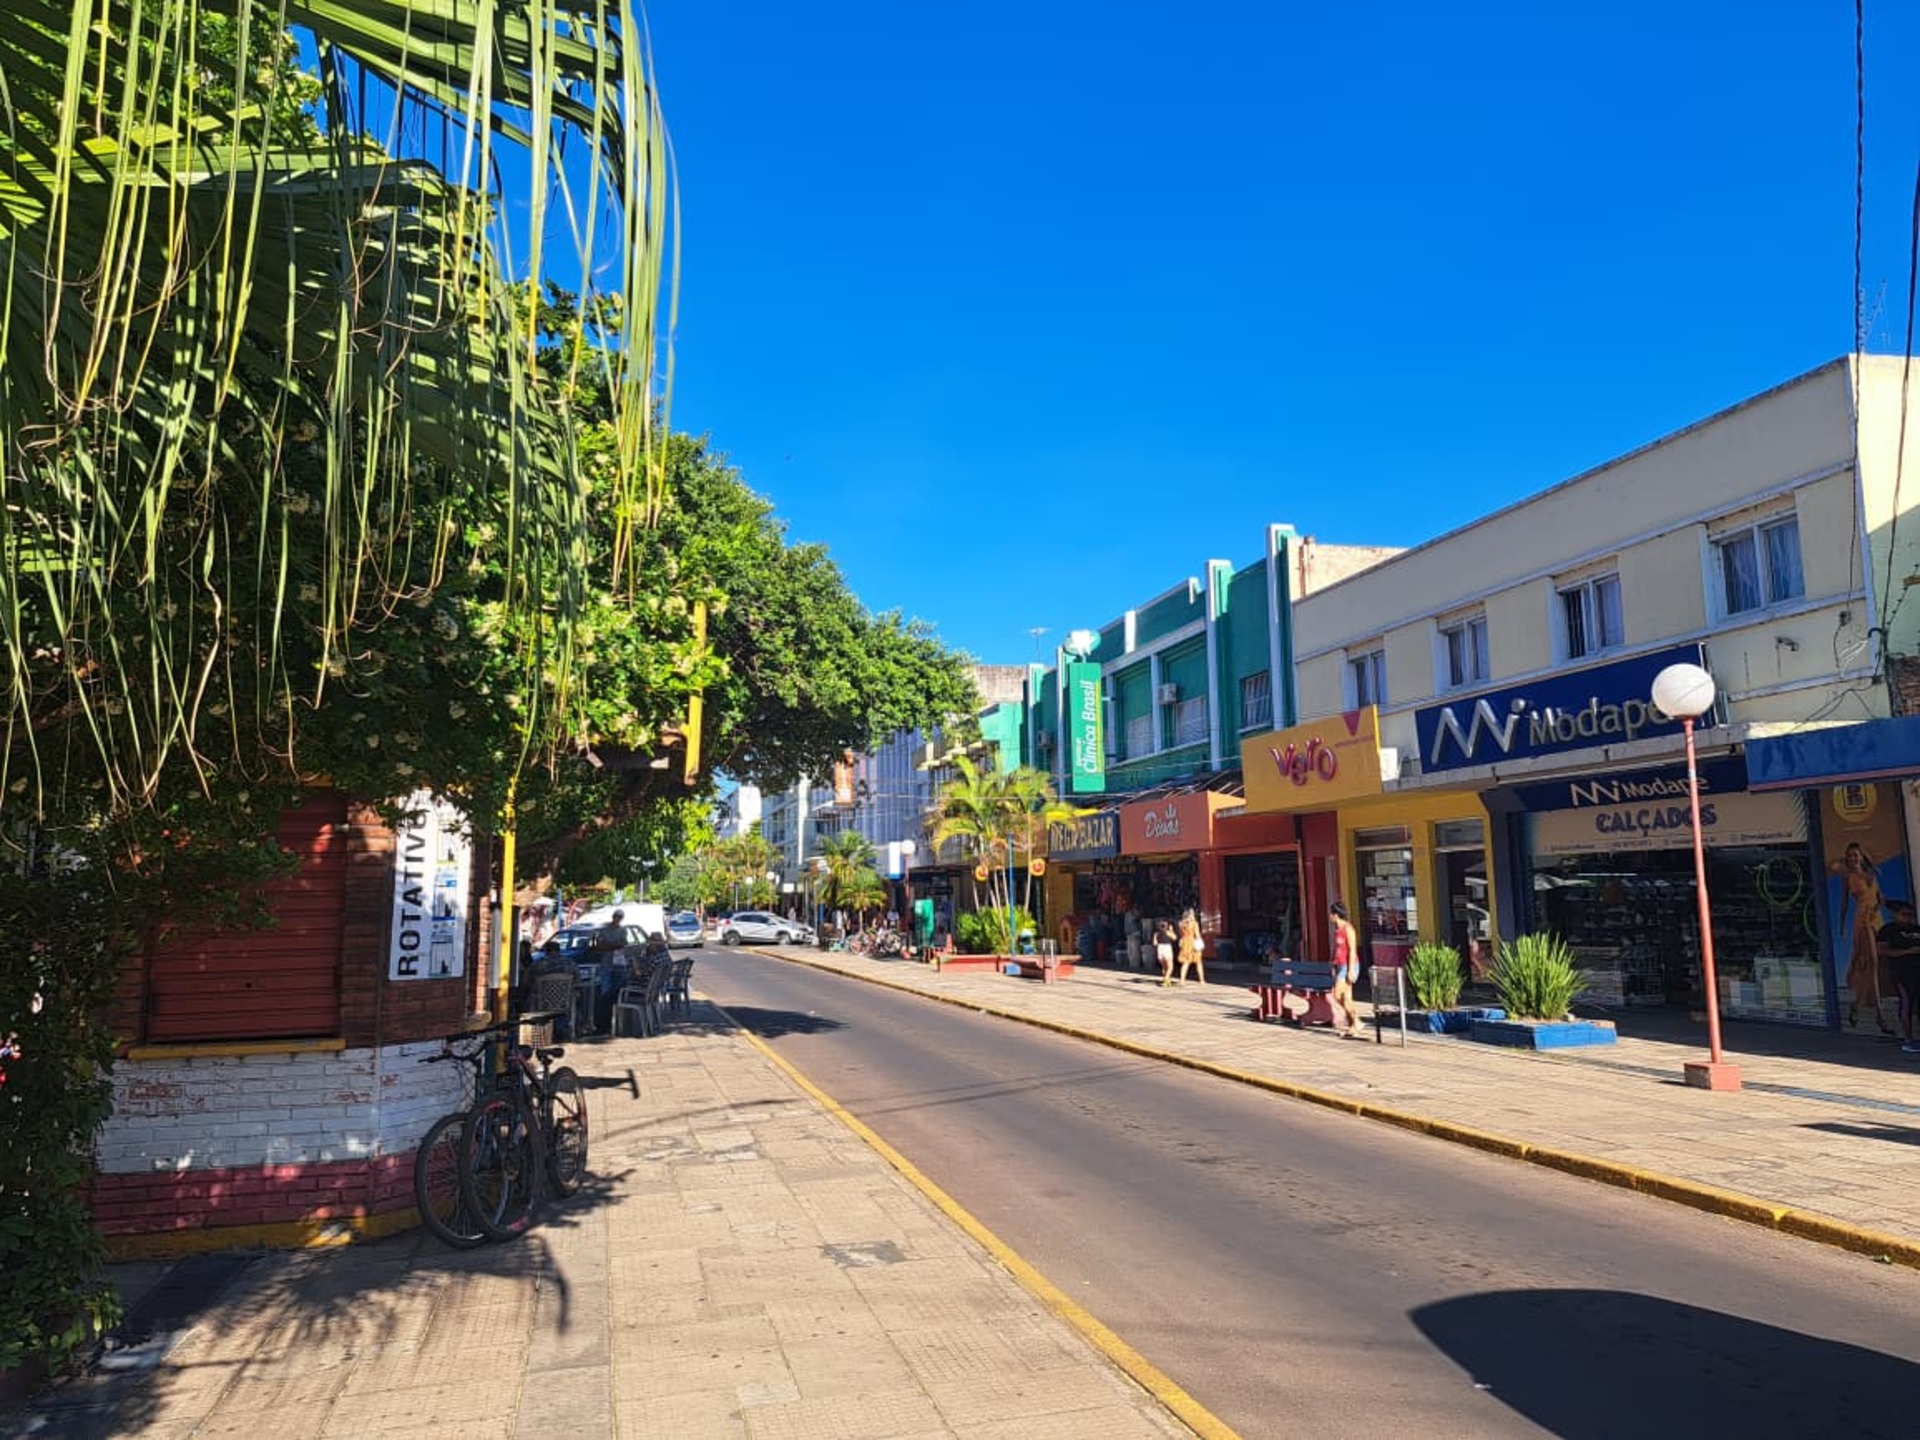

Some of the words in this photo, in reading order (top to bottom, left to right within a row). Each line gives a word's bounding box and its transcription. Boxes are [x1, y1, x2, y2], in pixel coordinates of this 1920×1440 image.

[1080, 680, 1096, 721] Brasil
[1079, 815, 1114, 849] BAZAR
[1144, 810, 1180, 839] Divas
[1595, 803, 1717, 837] CALÇADOS
